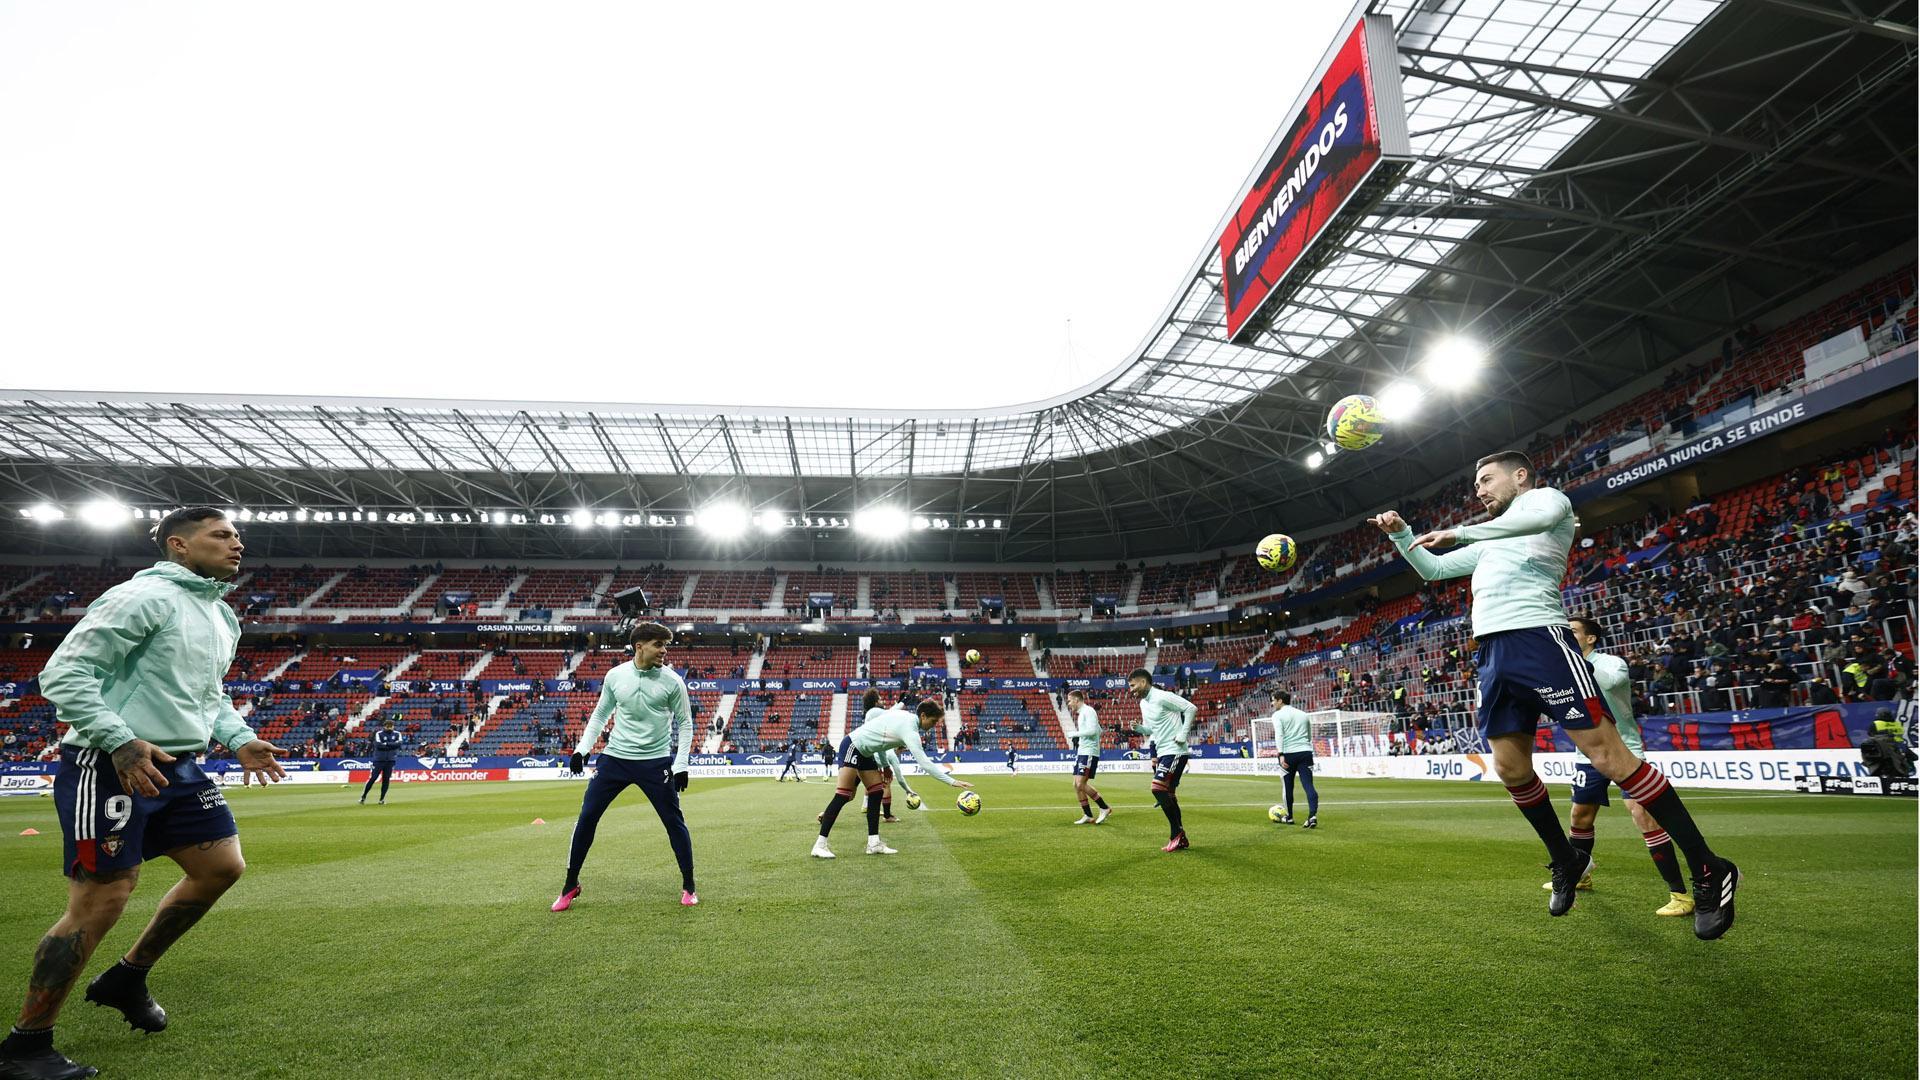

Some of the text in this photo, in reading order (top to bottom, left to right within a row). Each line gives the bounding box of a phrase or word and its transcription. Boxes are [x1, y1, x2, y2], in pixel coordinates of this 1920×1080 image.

[1234, 102, 1348, 275] BIENVENIDOS
[1607, 403, 1806, 489] OSASUNA NUNCA SE RINDE
[477, 624, 577, 632] OSASUNA NUNCA SE RINDE
[851, 755, 858, 765] 6
[430, 770, 489, 781] Santander
[728, 767, 774, 775] TRANSPORTE
[1426, 760, 1463, 779] Jaylo
[1759, 761, 1791, 781] DE
[3, 778, 35, 787] Jaylo
[1572, 767, 1587, 788] 20
[1855, 780, 1879, 788] Cam
[104, 795, 132, 832] 9
